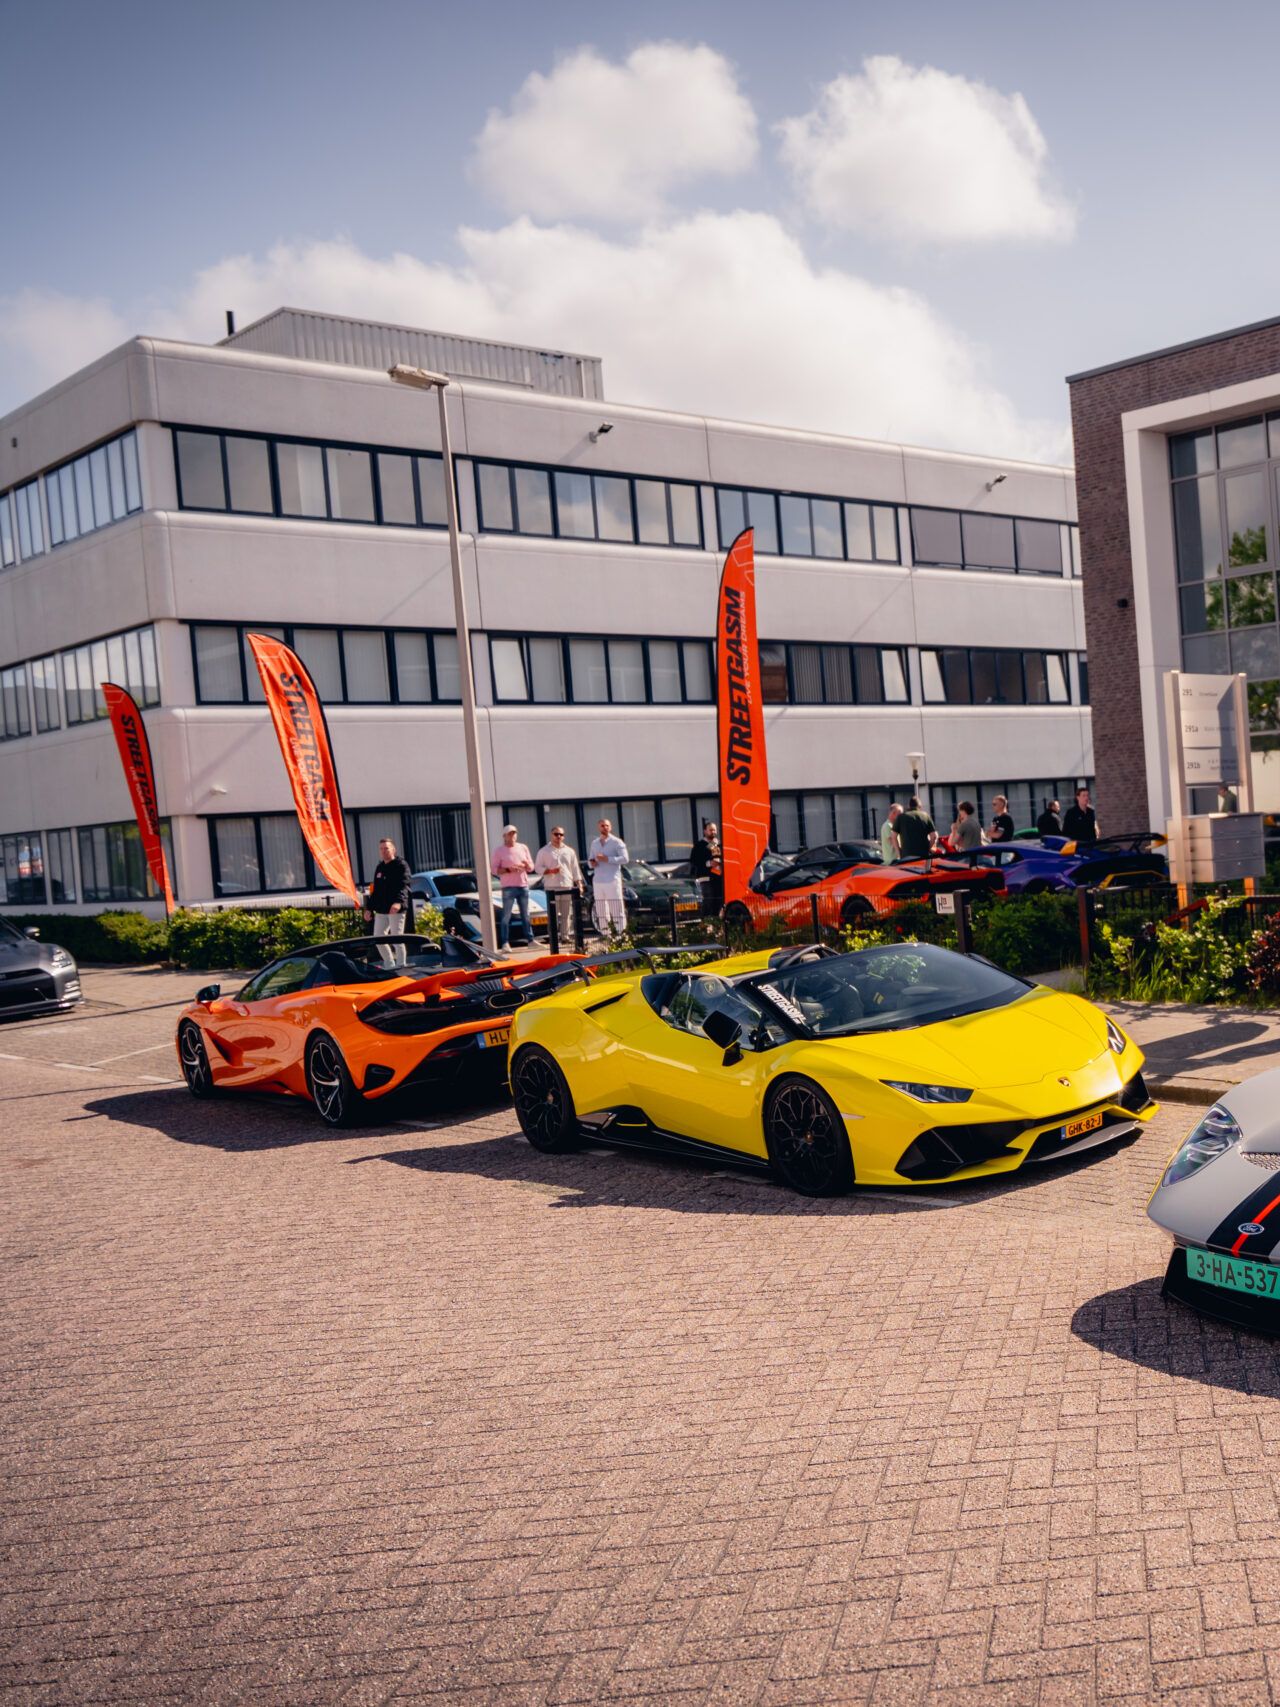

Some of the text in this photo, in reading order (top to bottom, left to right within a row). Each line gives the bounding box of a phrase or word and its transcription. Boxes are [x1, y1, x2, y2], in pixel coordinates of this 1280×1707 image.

[725, 585, 753, 786] STREETGASM
[280, 672, 331, 821] STREETGASM
[1068, 1115, 1101, 1136] GHK-82-J
[1196, 1254, 1279, 1294] 3-HA-537
